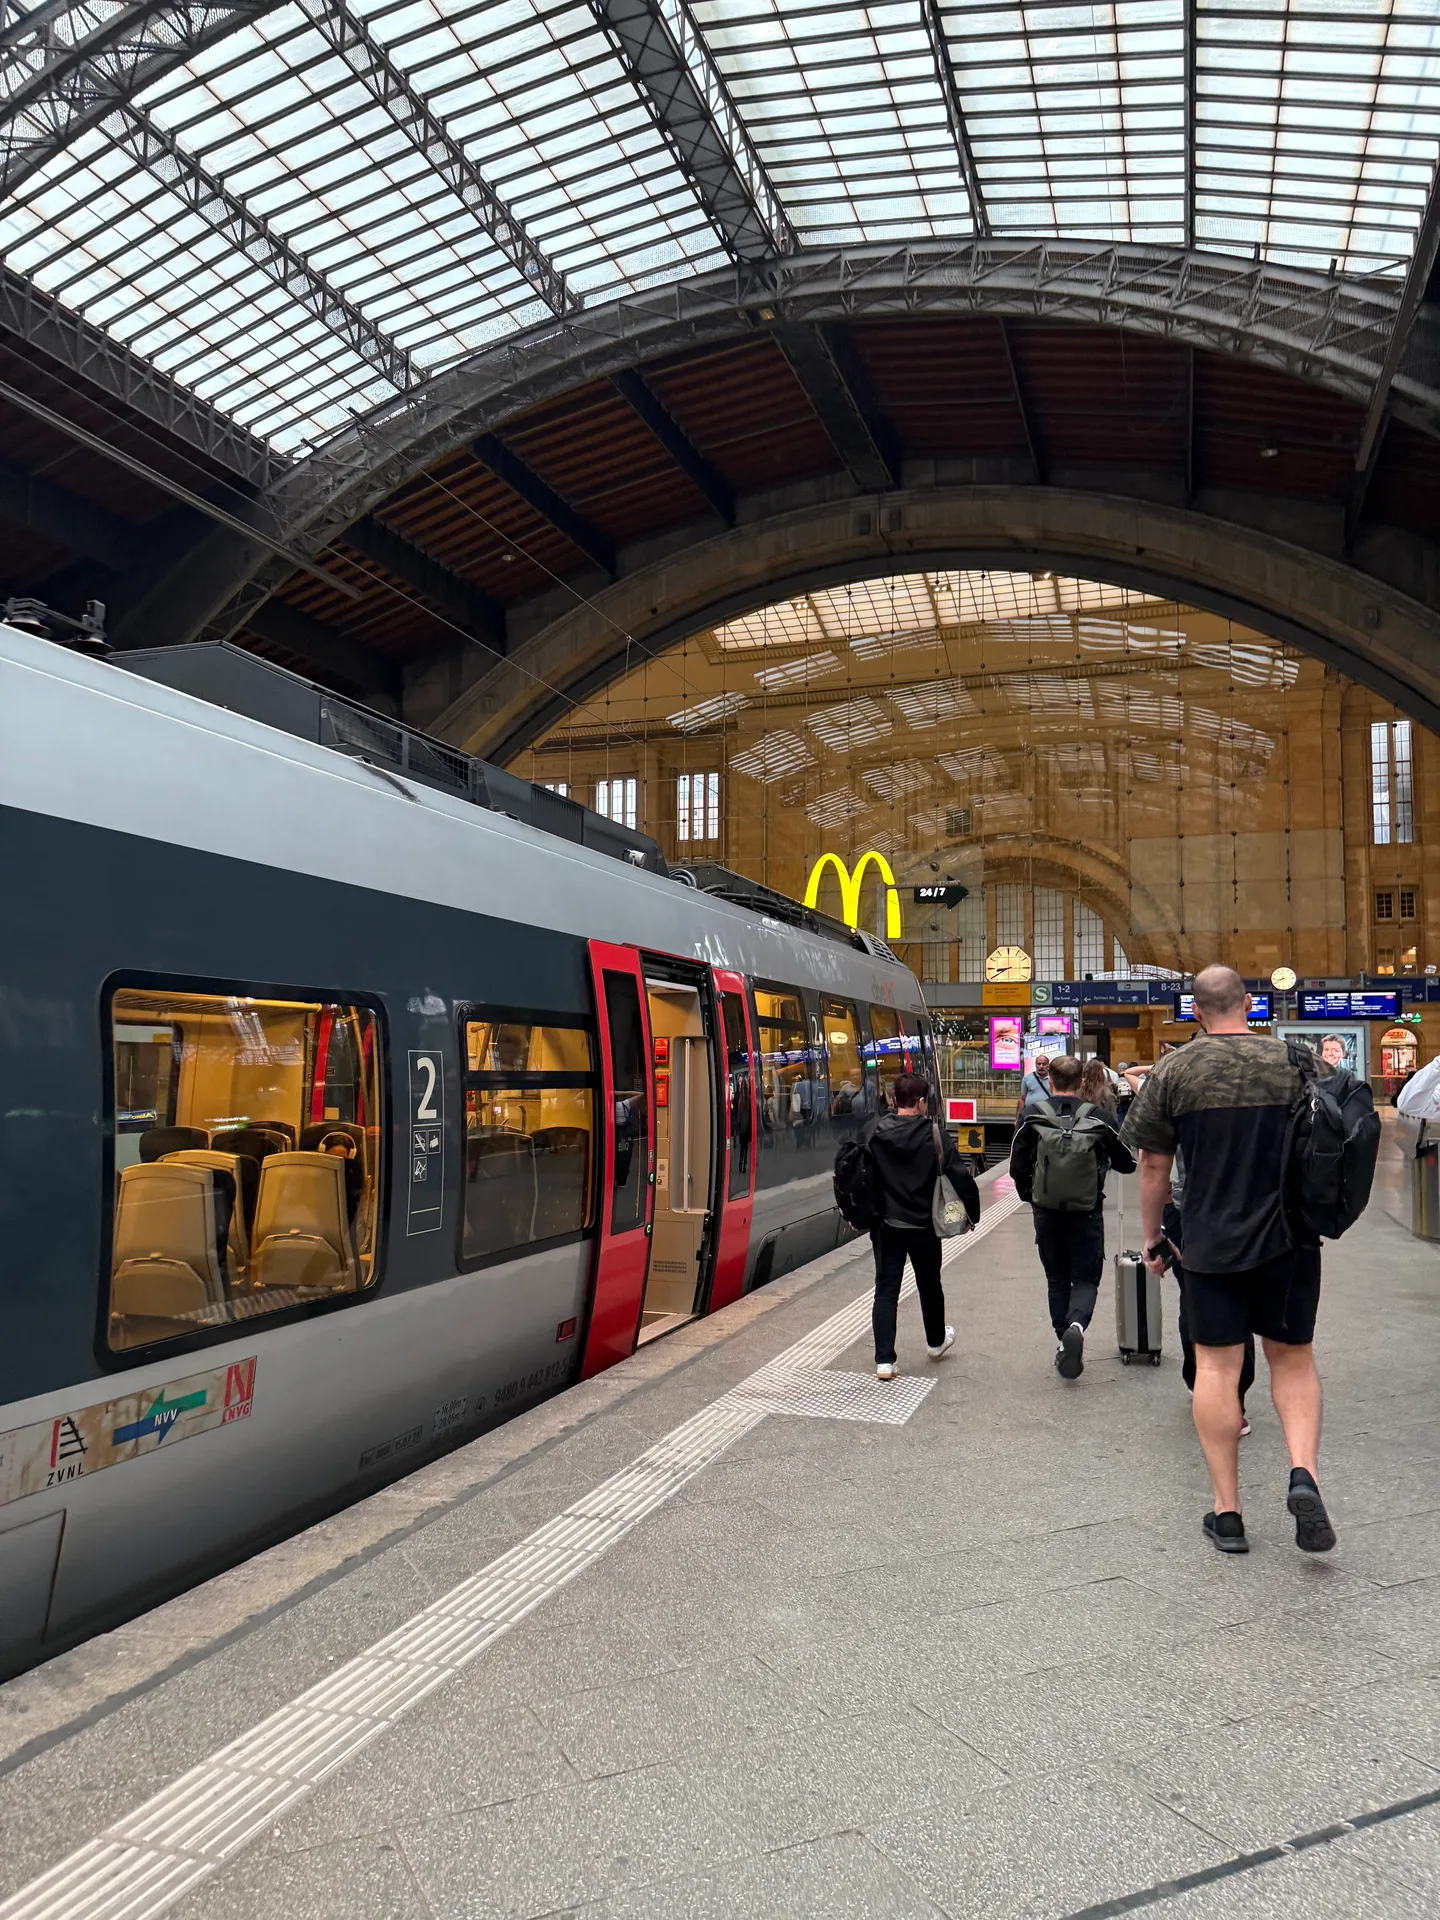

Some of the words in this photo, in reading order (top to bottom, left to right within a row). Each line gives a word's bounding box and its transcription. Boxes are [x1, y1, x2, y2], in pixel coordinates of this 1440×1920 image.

[1035, 987, 1048, 1002] S
[1058, 985, 1070, 993] 1-2
[1161, 983, 1181, 991] 8-23
[416, 1056, 438, 1120] 2
[494, 1381, 518, 1407] 9480
[154, 1408, 178, 1427] NVV
[221, 1404, 250, 1425] LNVG
[46, 1462, 85, 1487] ZVNL
